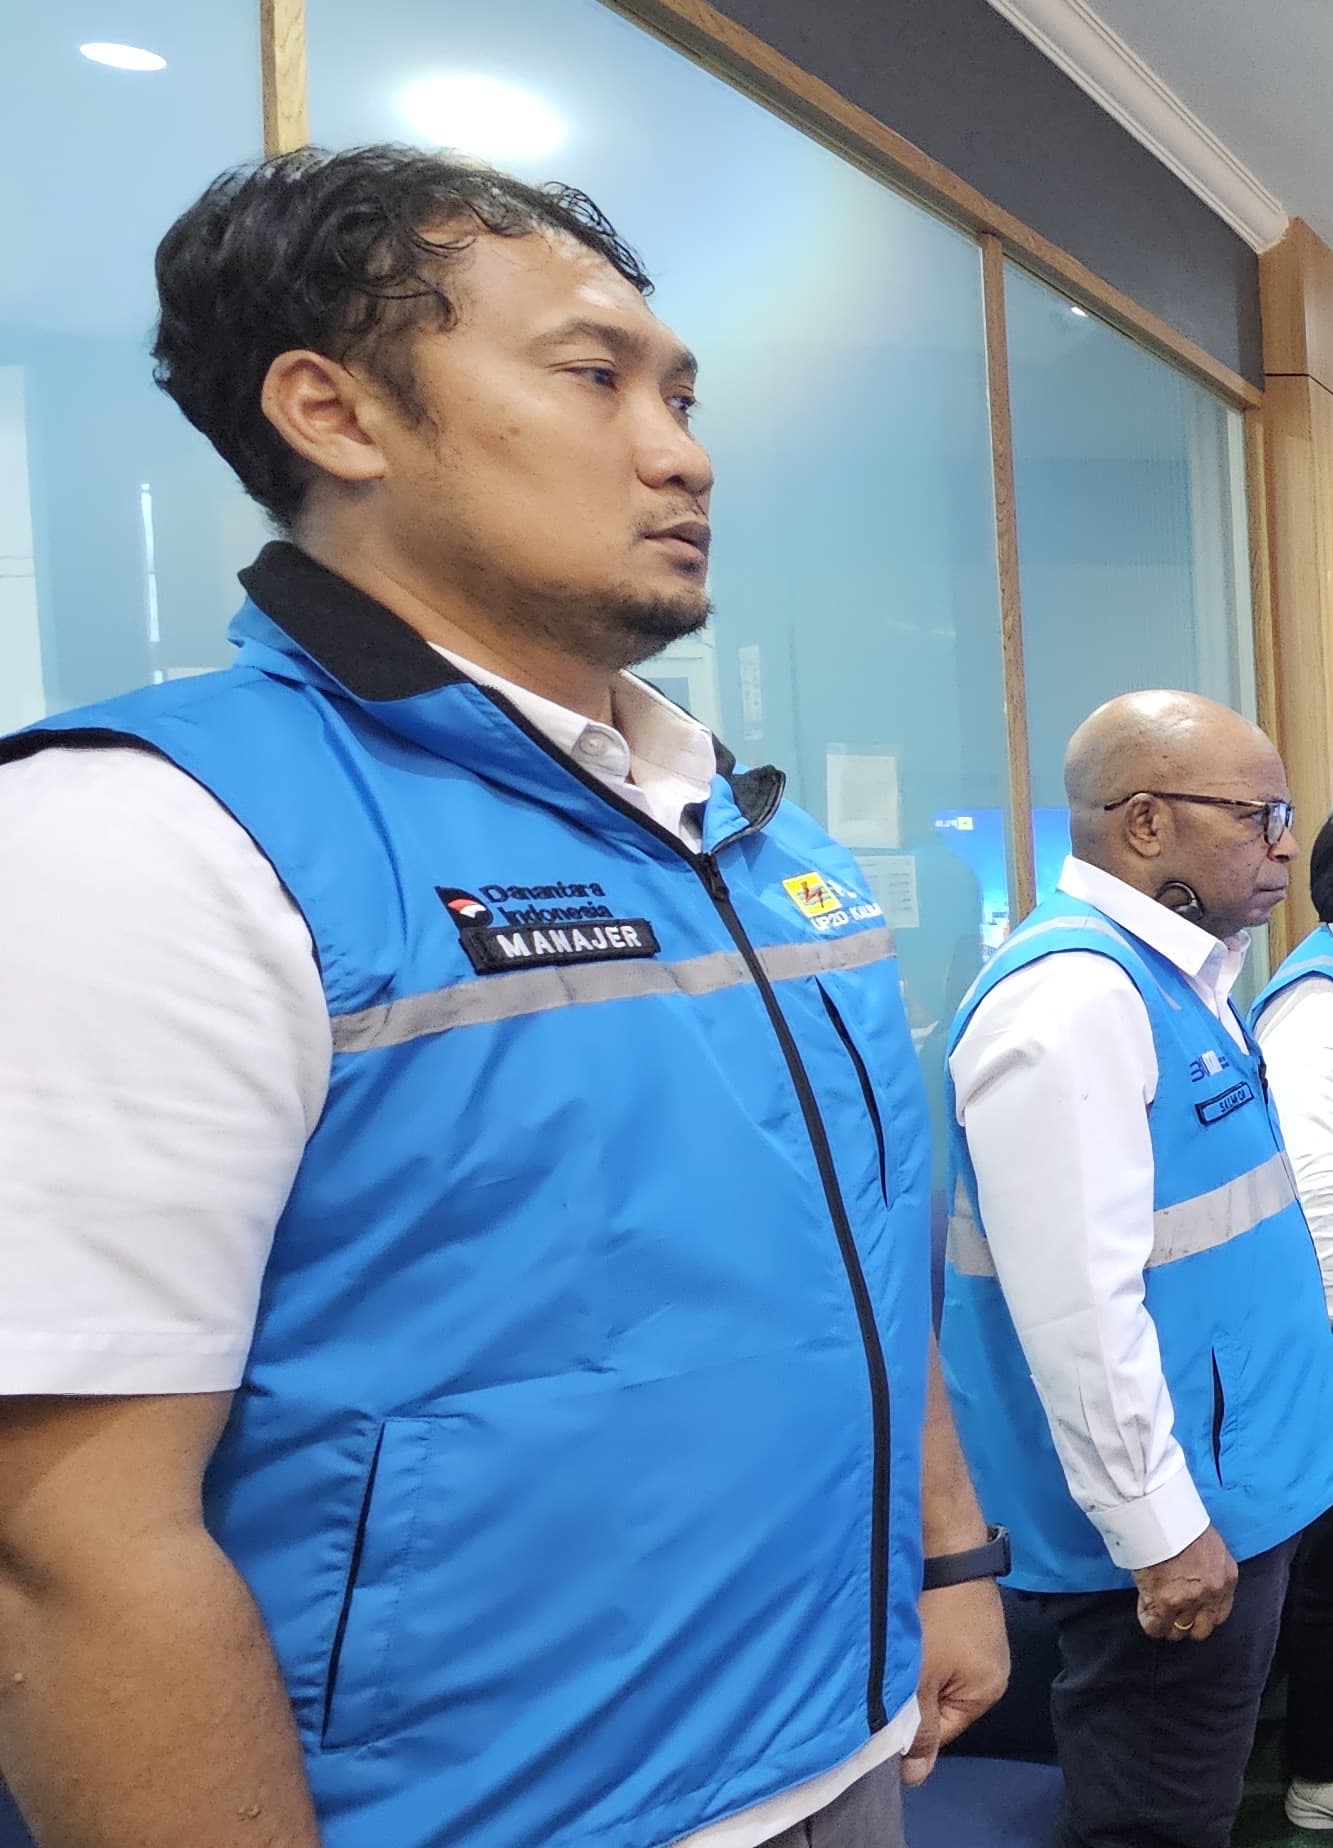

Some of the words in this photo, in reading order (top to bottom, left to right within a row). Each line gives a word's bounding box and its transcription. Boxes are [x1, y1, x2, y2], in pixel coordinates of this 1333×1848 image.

[484, 881, 606, 901] Danantara
[502, 901, 614, 925] Indonesia
[496, 925, 643, 959] MANAJER
